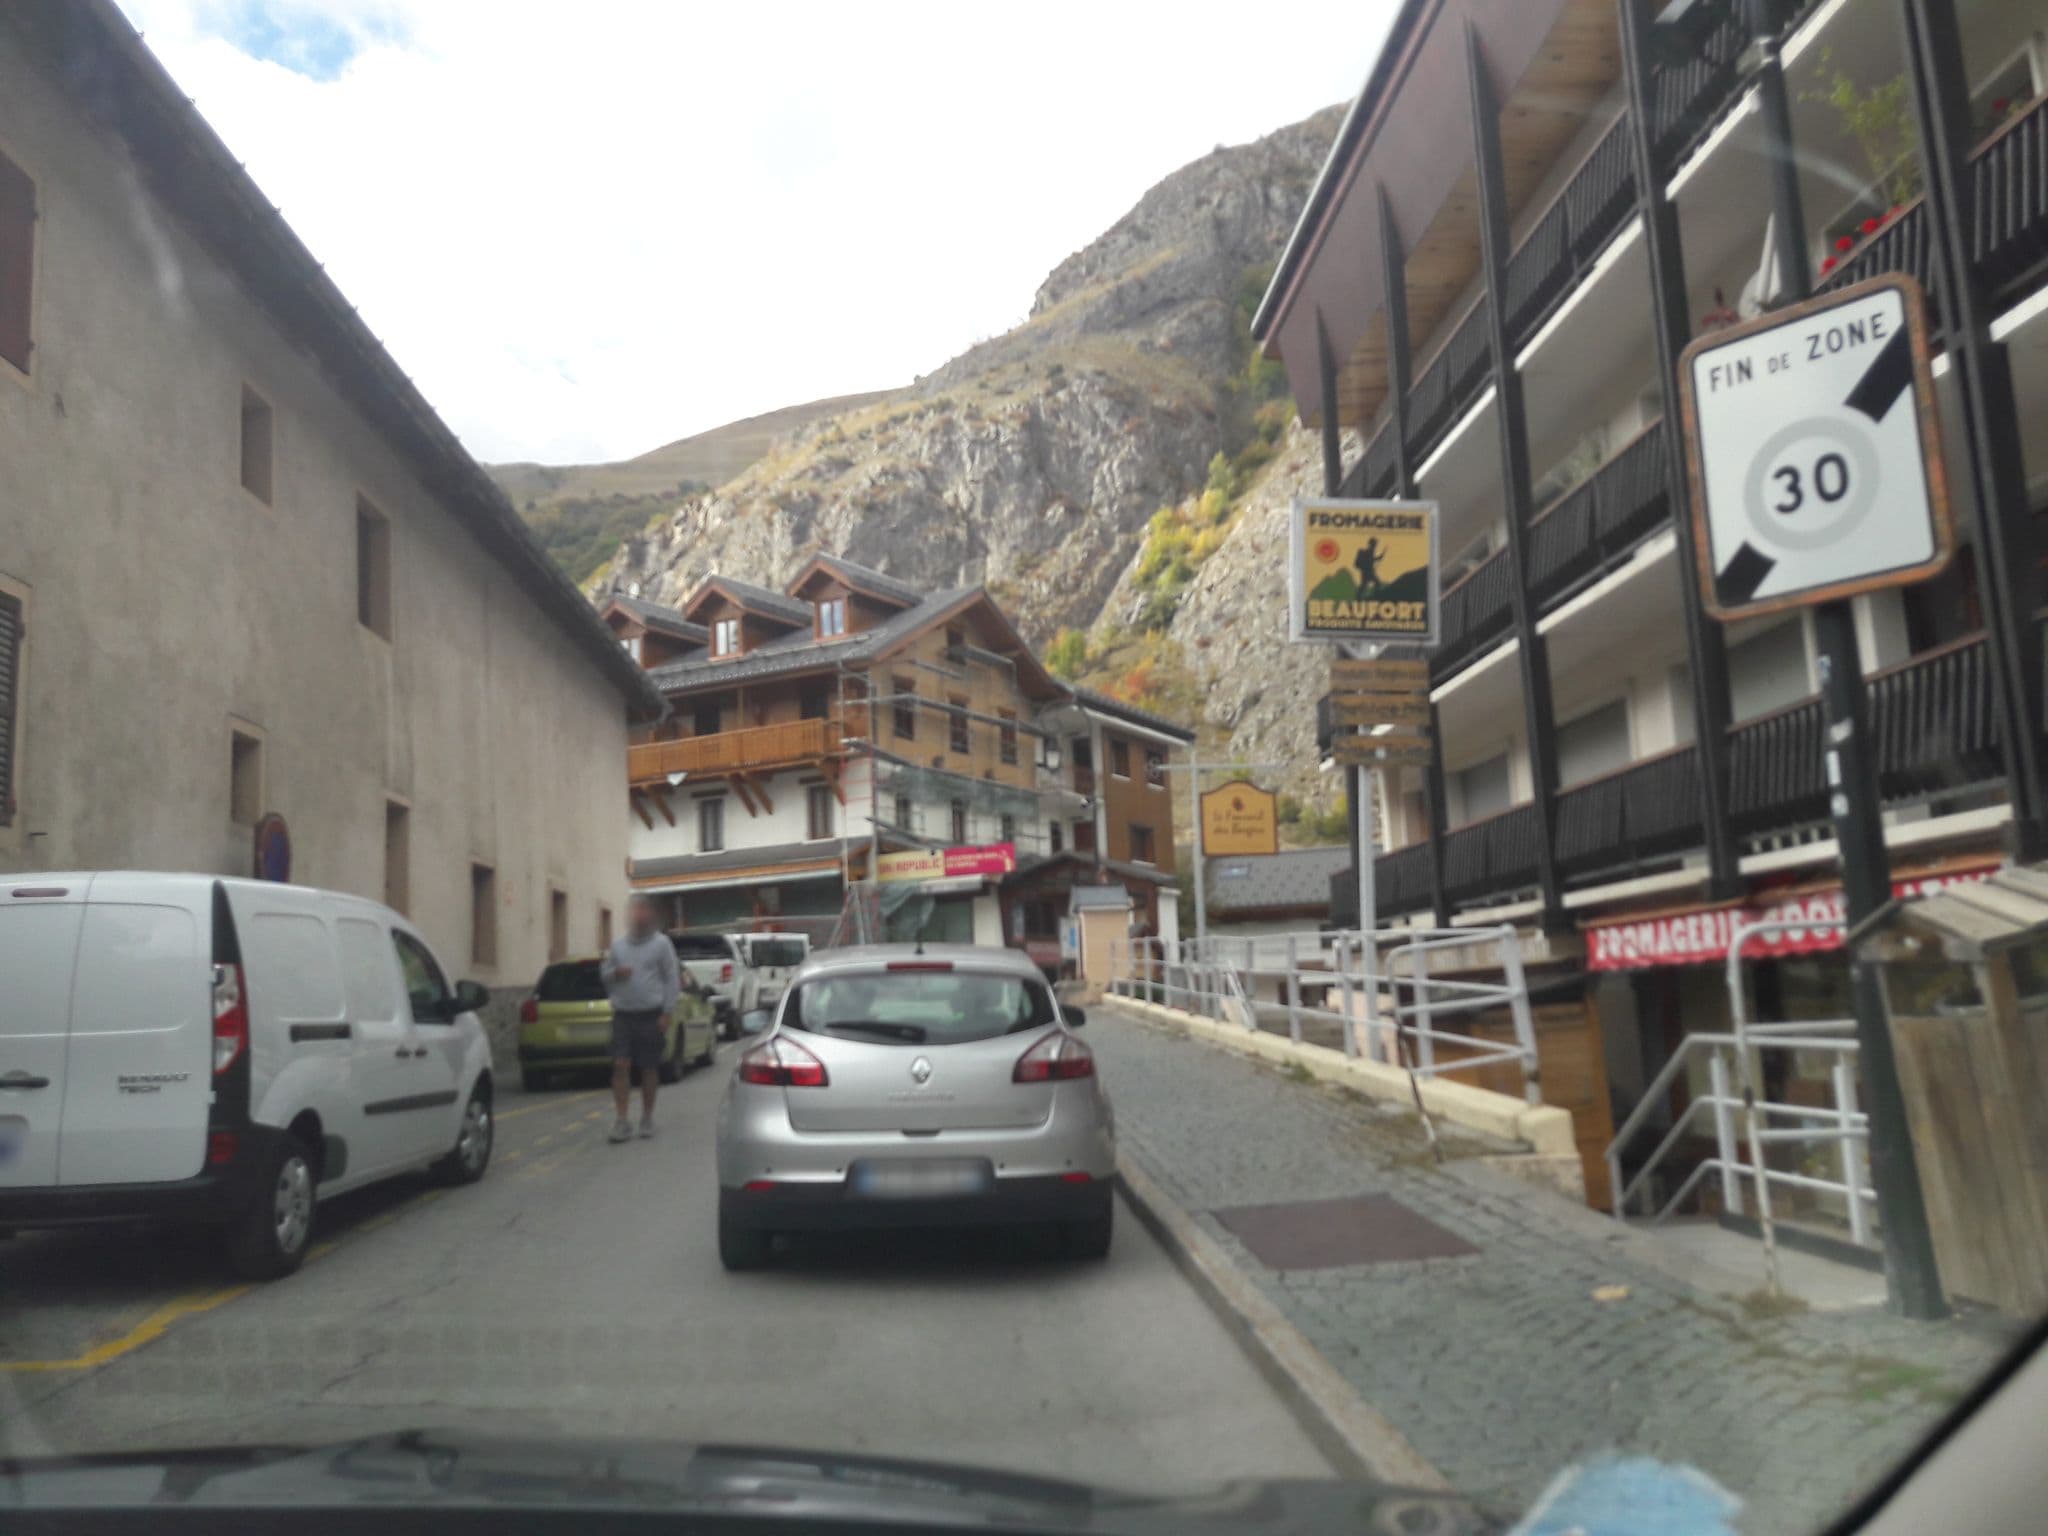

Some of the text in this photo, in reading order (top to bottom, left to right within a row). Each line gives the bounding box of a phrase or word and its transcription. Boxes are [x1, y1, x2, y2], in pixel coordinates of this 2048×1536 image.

[1709, 312, 1889, 392] FIN DE ZONE
[1773, 452, 1850, 515] 30
[1309, 512, 1424, 530] FROMAGERIE
[1308, 599, 1425, 620] BEAUFORT
[1595, 908, 1742, 961] FROMAGERIE
